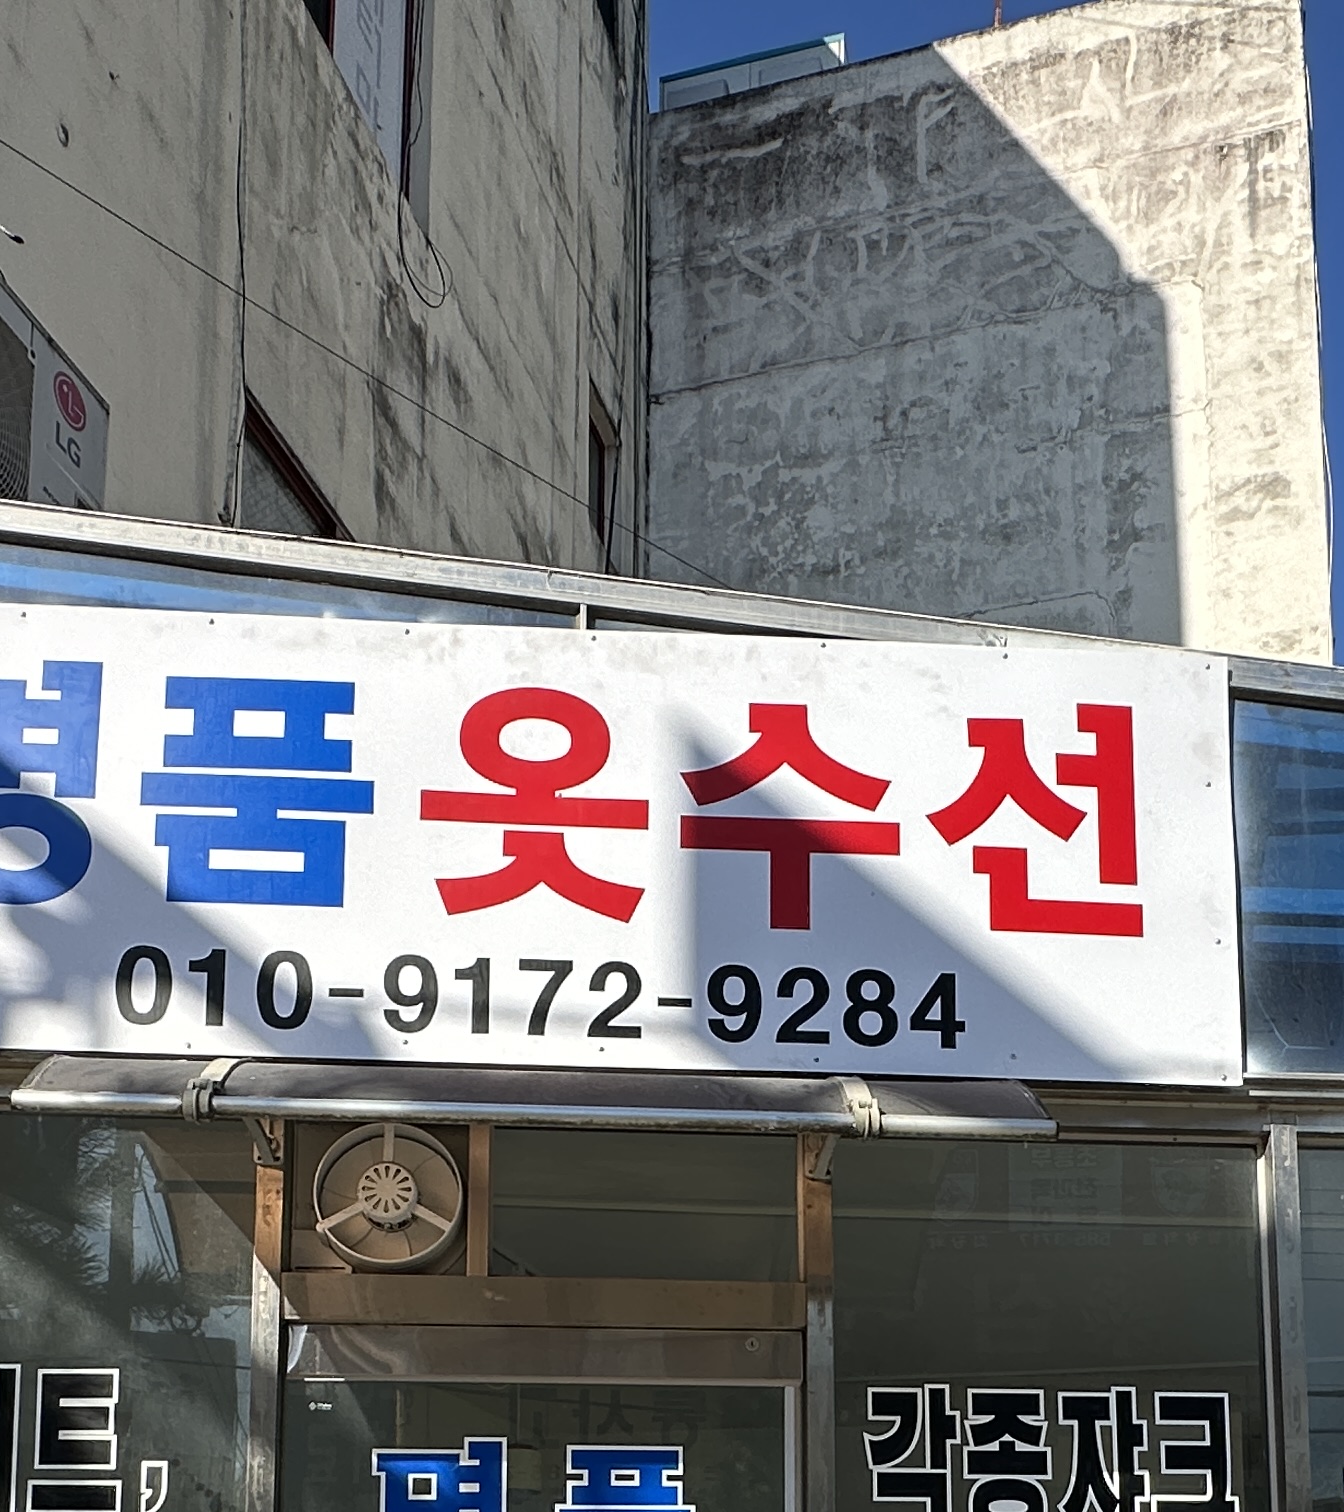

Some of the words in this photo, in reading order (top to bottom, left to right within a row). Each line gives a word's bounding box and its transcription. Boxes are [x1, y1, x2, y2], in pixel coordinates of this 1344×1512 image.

[55, 420, 82, 469] LG
[419, 687, 1145, 938] 옷수선
[115, 944, 966, 1051] 010-9172-9284
